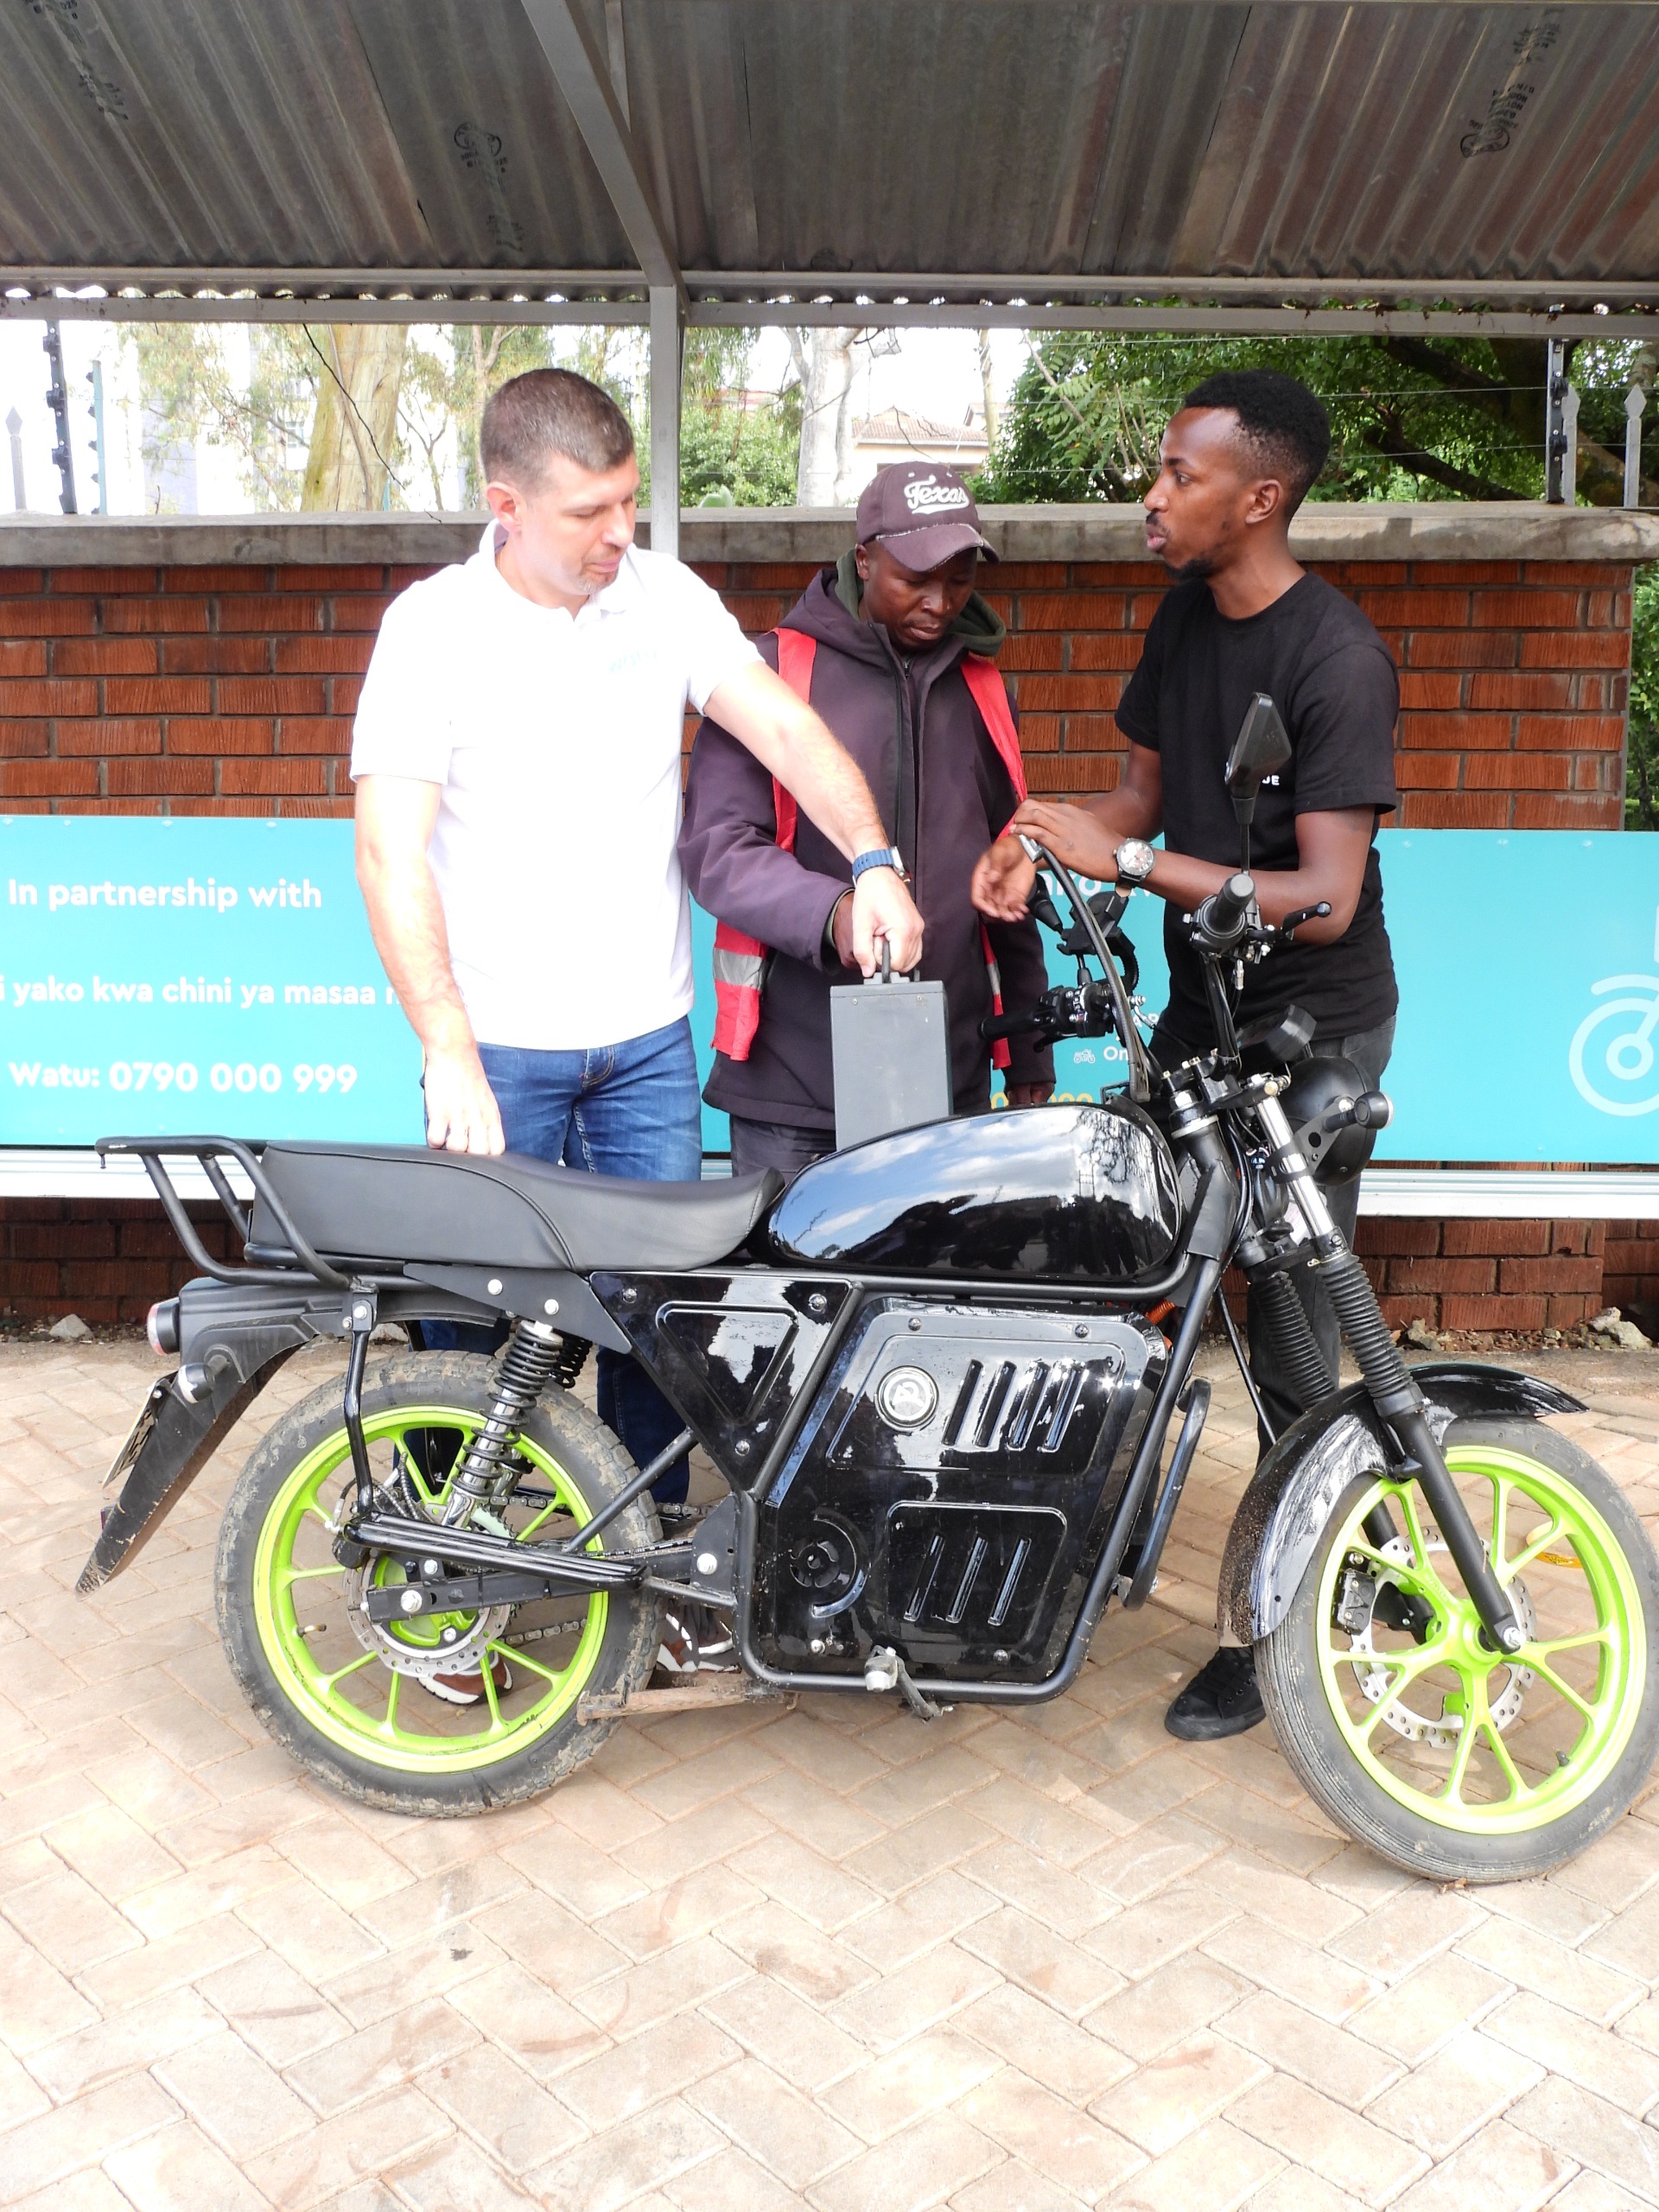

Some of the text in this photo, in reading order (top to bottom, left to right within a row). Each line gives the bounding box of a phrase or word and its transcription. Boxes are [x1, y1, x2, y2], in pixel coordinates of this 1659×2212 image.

[904, 474, 969, 513] Texas
[8, 877, 322, 913] In partnership with
[13, 975, 85, 1007] yako
[92, 975, 154, 1003] kwa
[162, 976, 232, 1003] chini
[239, 984, 275, 1009] ya
[283, 985, 376, 1005] masaa
[8, 1061, 358, 1093] Watu: 0790 000 999
